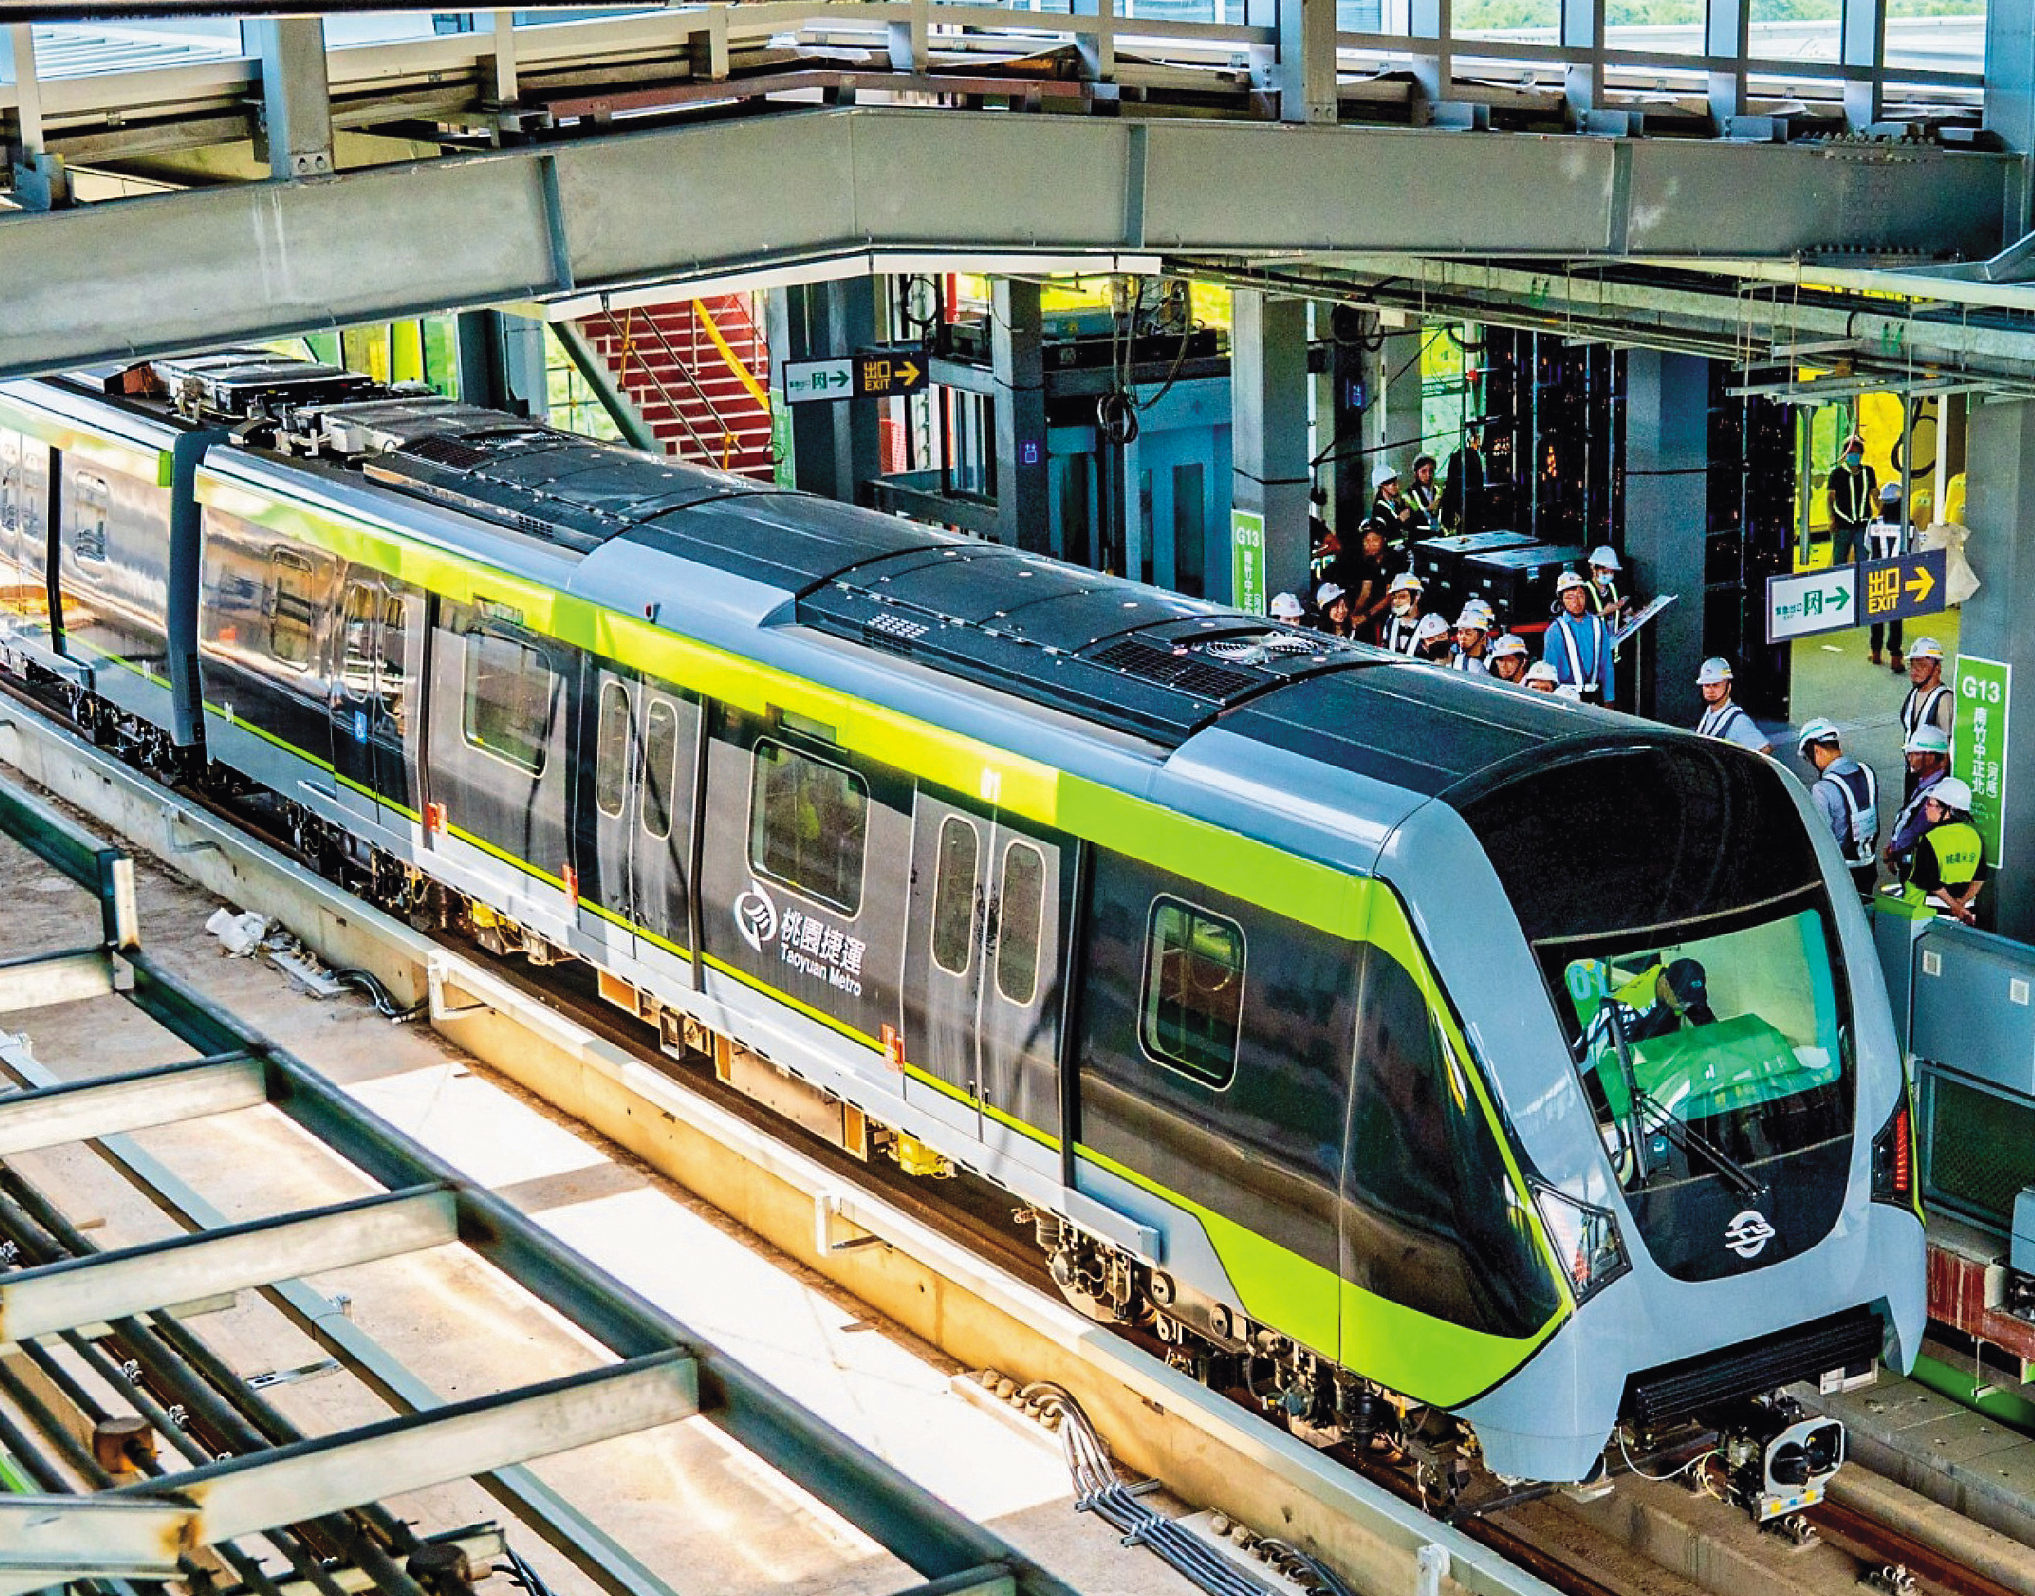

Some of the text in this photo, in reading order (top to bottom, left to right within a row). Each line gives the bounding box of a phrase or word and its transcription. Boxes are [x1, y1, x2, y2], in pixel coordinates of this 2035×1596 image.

[864, 360, 891, 379] 出口
[865, 379, 891, 391] EXIT
[1237, 528, 1259, 547] G13
[1869, 566, 1900, 597] 出口
[1869, 595, 1899, 613] EXIT
[1962, 676, 2001, 703] G13
[781, 907, 866, 975] 桃園捷運
[781, 942, 861, 997] Taoyuan Metro
